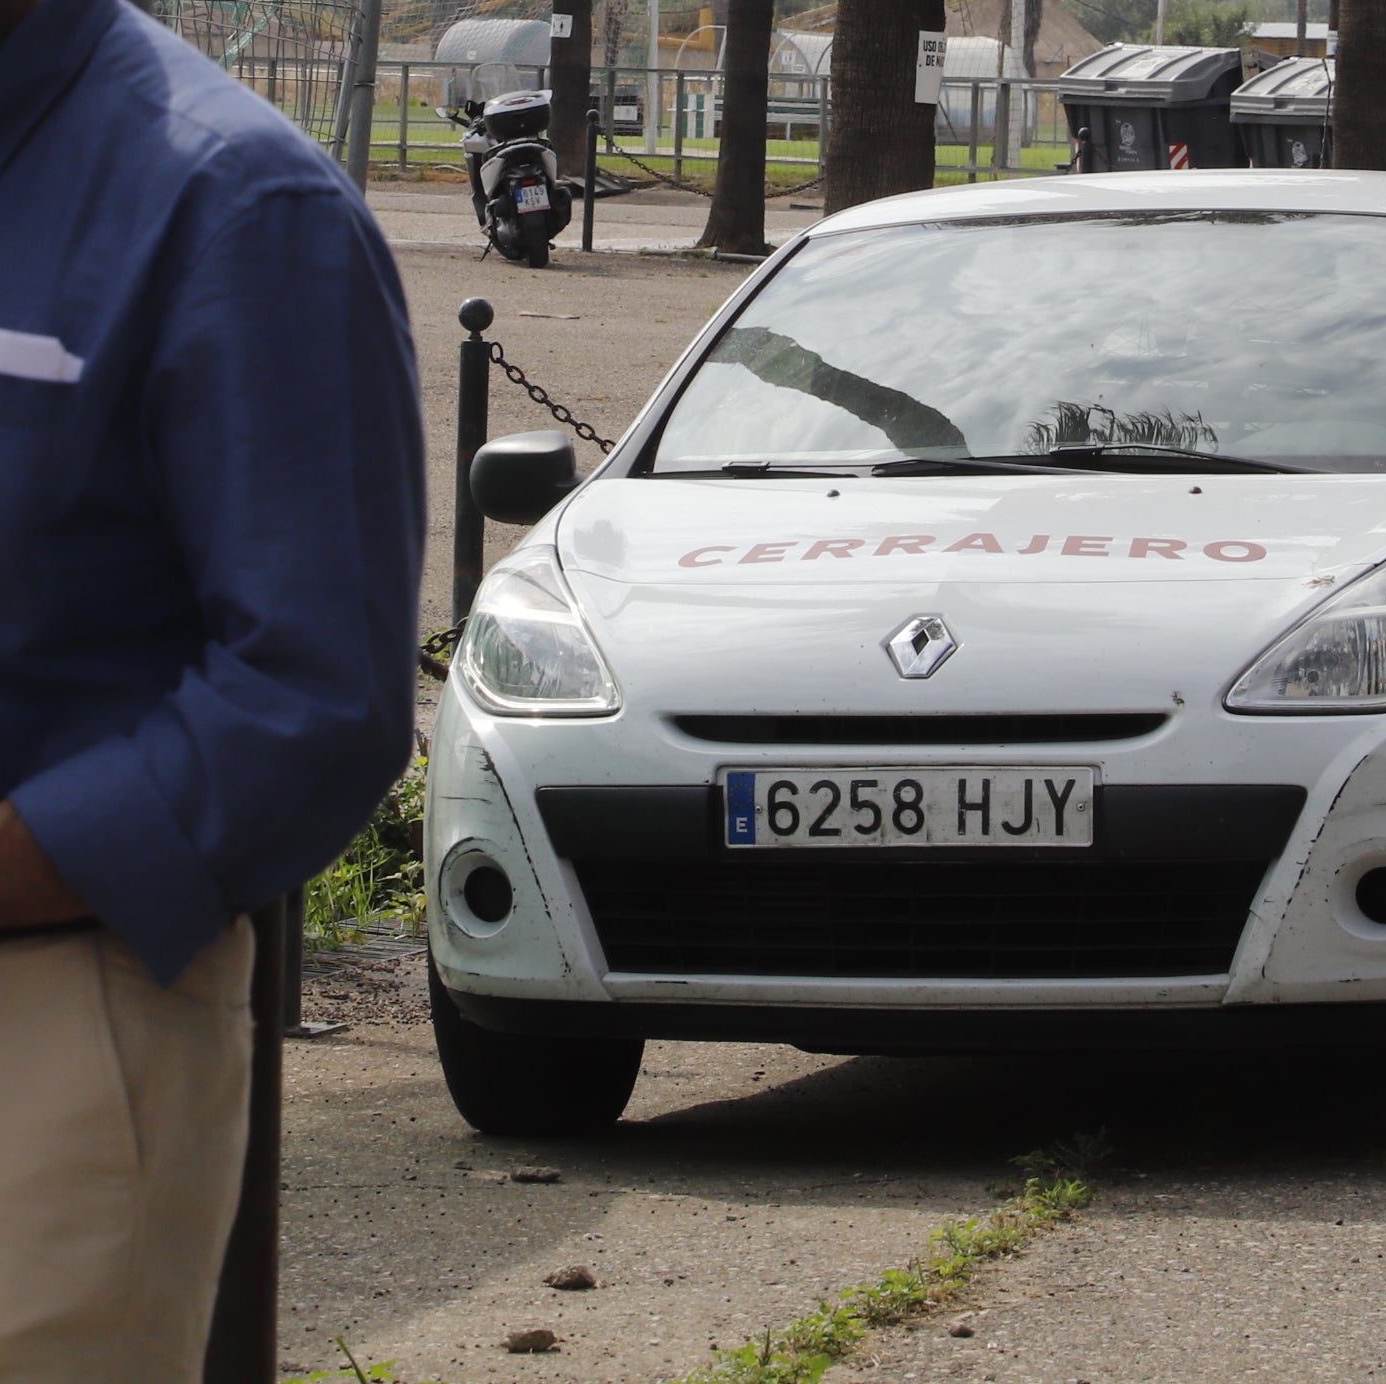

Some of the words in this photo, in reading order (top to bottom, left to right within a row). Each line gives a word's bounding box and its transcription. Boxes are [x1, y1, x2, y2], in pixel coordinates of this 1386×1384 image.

[923, 40, 936, 52] USO
[925, 55, 935, 66] DE
[678, 532, 1267, 568] CERRAJERO
[736, 817, 747, 833] E
[767, 779, 925, 837] 6258
[958, 778, 1075, 836] HJY
